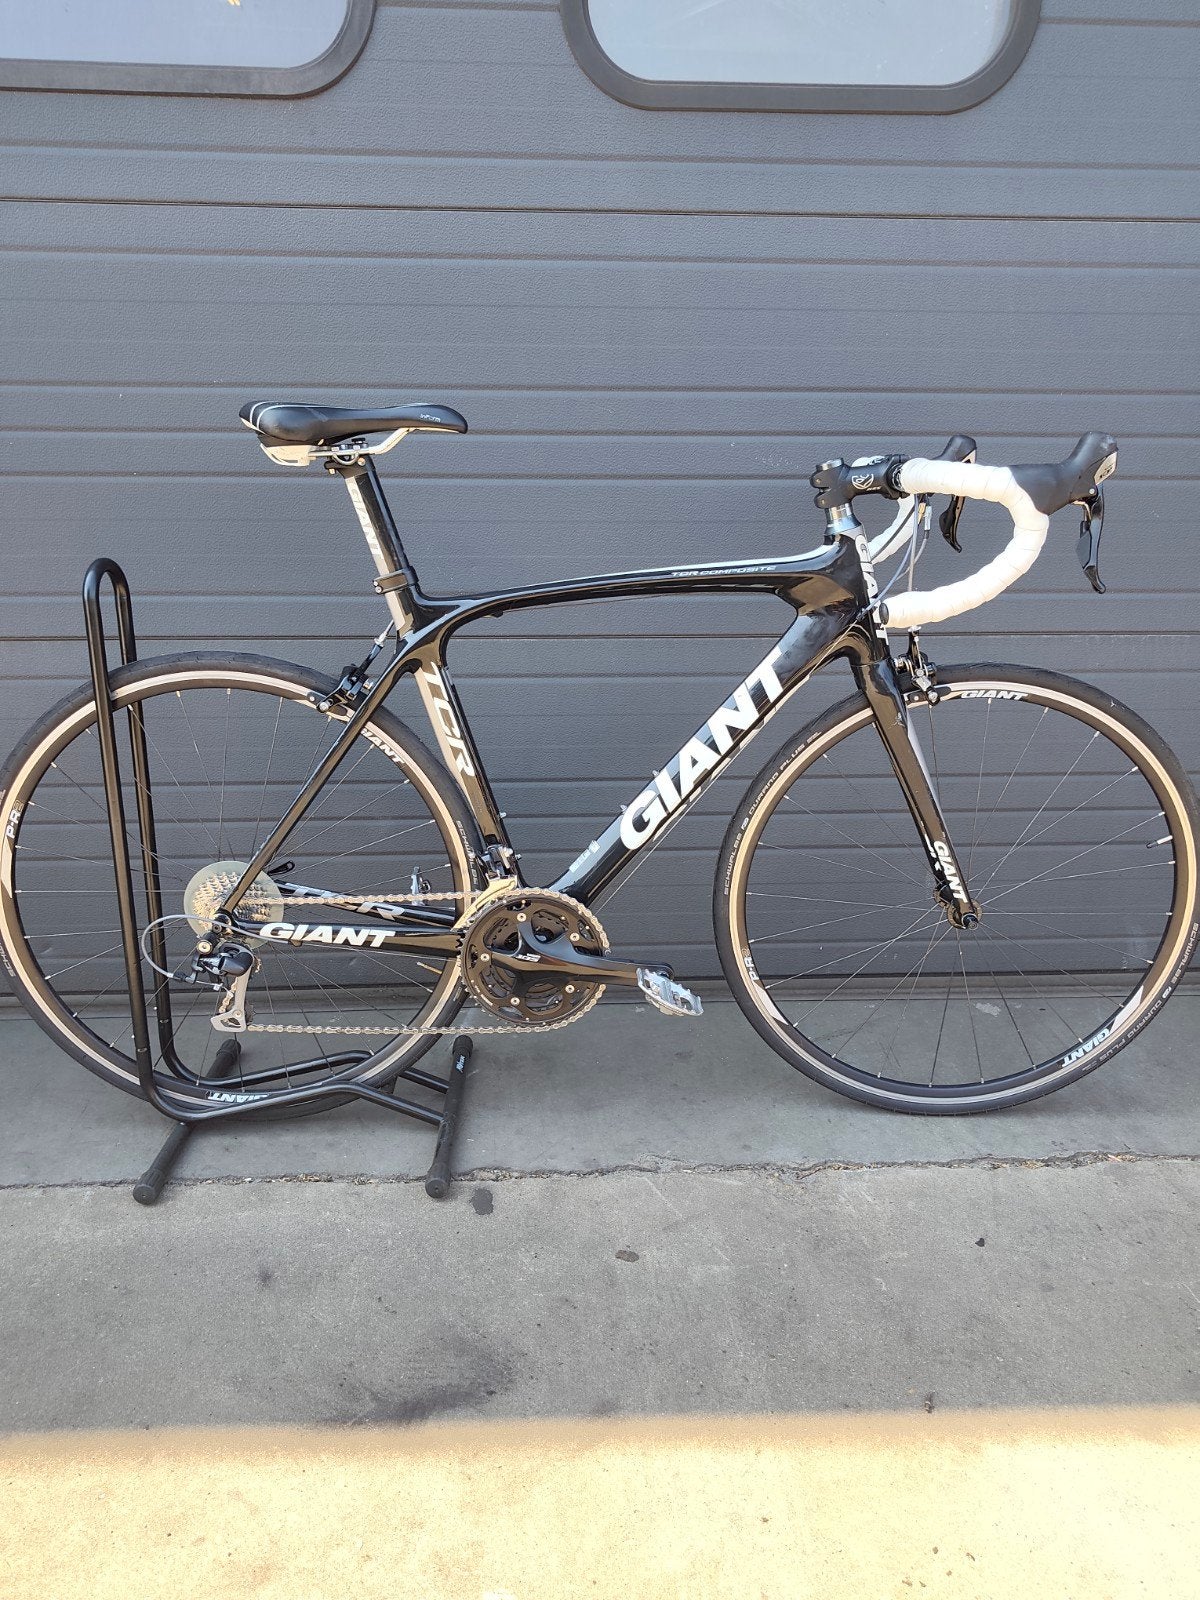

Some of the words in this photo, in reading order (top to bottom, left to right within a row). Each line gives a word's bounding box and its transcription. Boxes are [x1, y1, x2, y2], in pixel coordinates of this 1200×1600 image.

[700, 564, 777, 577] COMPOSITE
[423, 661, 477, 778] TCR
[960, 689, 1029, 701] GIANT
[619, 645, 784, 850] GIANT
[723, 832, 744, 897] SCHWALBE
[779, 742, 806, 772] PLUS
[933, 840, 969, 904] GIANT
[259, 922, 396, 948] GIANT
[1171, 922, 1199, 985] SCHWALBE
[1061, 1028, 1112, 1068] GIANT
[1099, 1039, 1127, 1064] PLUS
